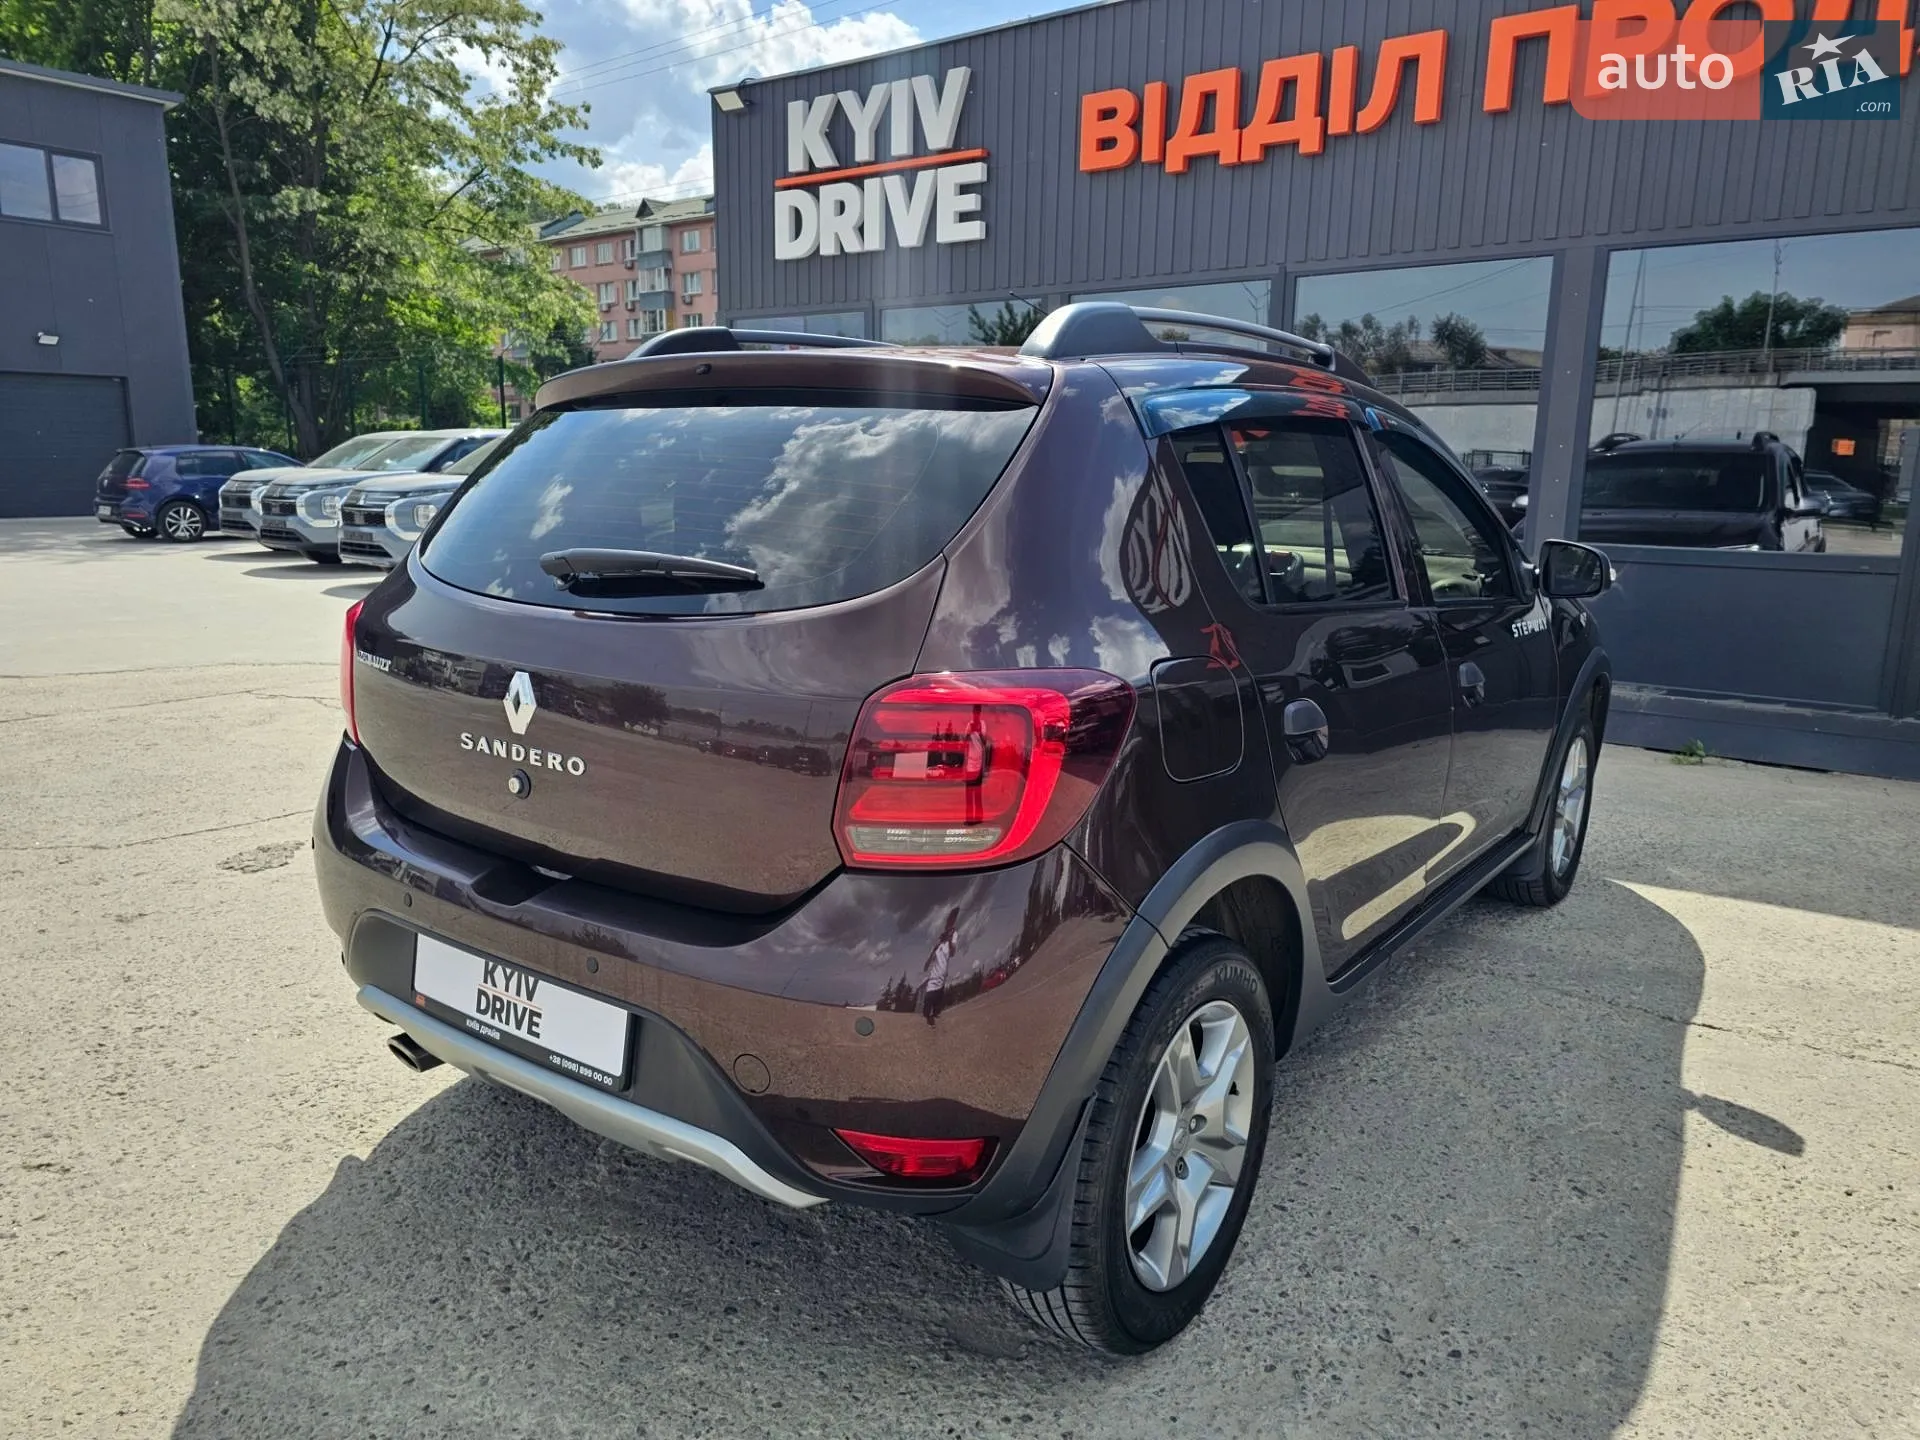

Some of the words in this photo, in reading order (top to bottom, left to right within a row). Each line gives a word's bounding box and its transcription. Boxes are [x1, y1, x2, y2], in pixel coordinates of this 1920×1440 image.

[1079, 29, 1448, 174] ВІДДІЛ
[1483, 0, 1920, 114] ПРОД
[787, 66, 972, 174] KYIV
[774, 161, 988, 260] DRIVE
[1511, 617, 1549, 638] STEPWAY
[460, 732, 586, 776] SANDERO
[482, 960, 542, 1002] KYIV
[1214, 962, 1259, 993] KUMHO
[476, 987, 543, 1039] DRIVE
[593, 1071, 603, 1082] 00
[603, 1075, 613, 1086] 00
